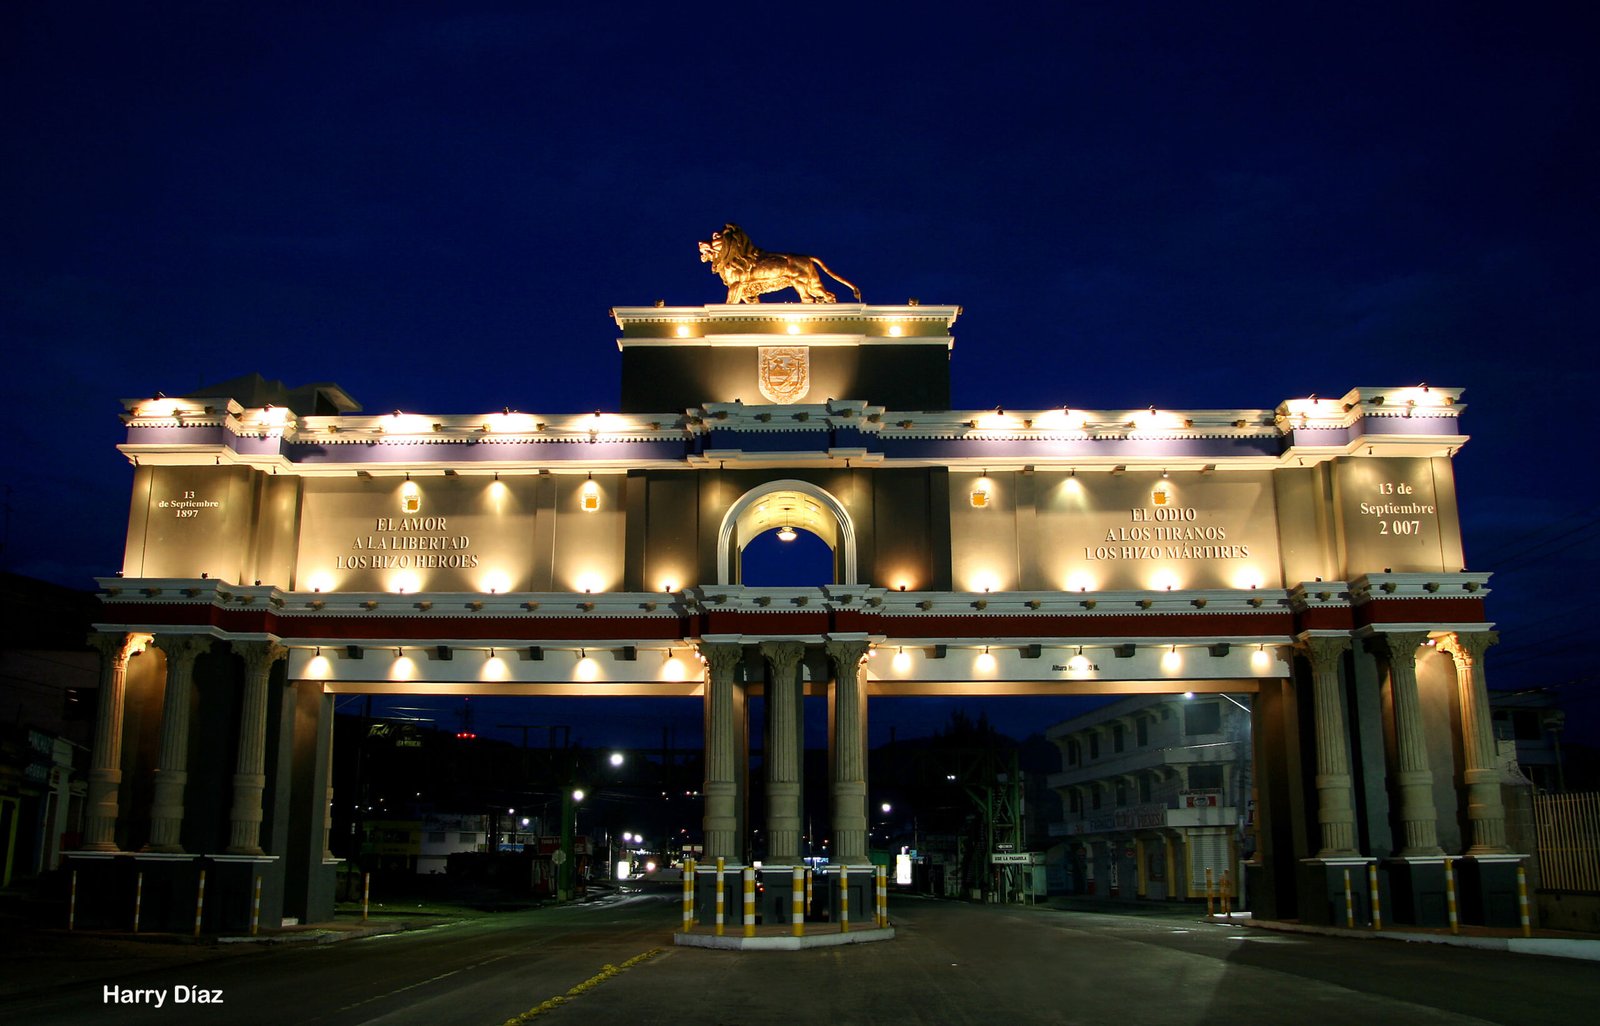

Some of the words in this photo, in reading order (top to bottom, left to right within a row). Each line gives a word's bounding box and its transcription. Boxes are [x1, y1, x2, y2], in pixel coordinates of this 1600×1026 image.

[184, 491, 195, 499] 13
[1379, 483, 1393, 495] 13
[1397, 483, 1412, 495] de
[158, 500, 169, 508] de
[170, 500, 219, 509] Septiembre
[1360, 502, 1434, 517] Septiembre
[176, 509, 199, 518] 1897
[1131, 508, 1153, 522] EL
[1154, 507, 1196, 522] ODIO
[376, 518, 397, 532] EL
[398, 517, 447, 531] AMOR
[1105, 528, 1116, 542] A
[1119, 527, 1151, 541] LOS
[1153, 526, 1226, 541] TIRANOS
[352, 536, 363, 550] A
[367, 536, 387, 550] LA
[390, 535, 470, 550] LIBERTAD
[1085, 546, 1117, 560] LOS
[1120, 546, 1162, 560] HIZO
[1164, 542, 1250, 559] MÁRTIRES
[335, 555, 367, 569] LOS
[370, 555, 411, 569] HIZO
[413, 554, 479, 569] HEROES
